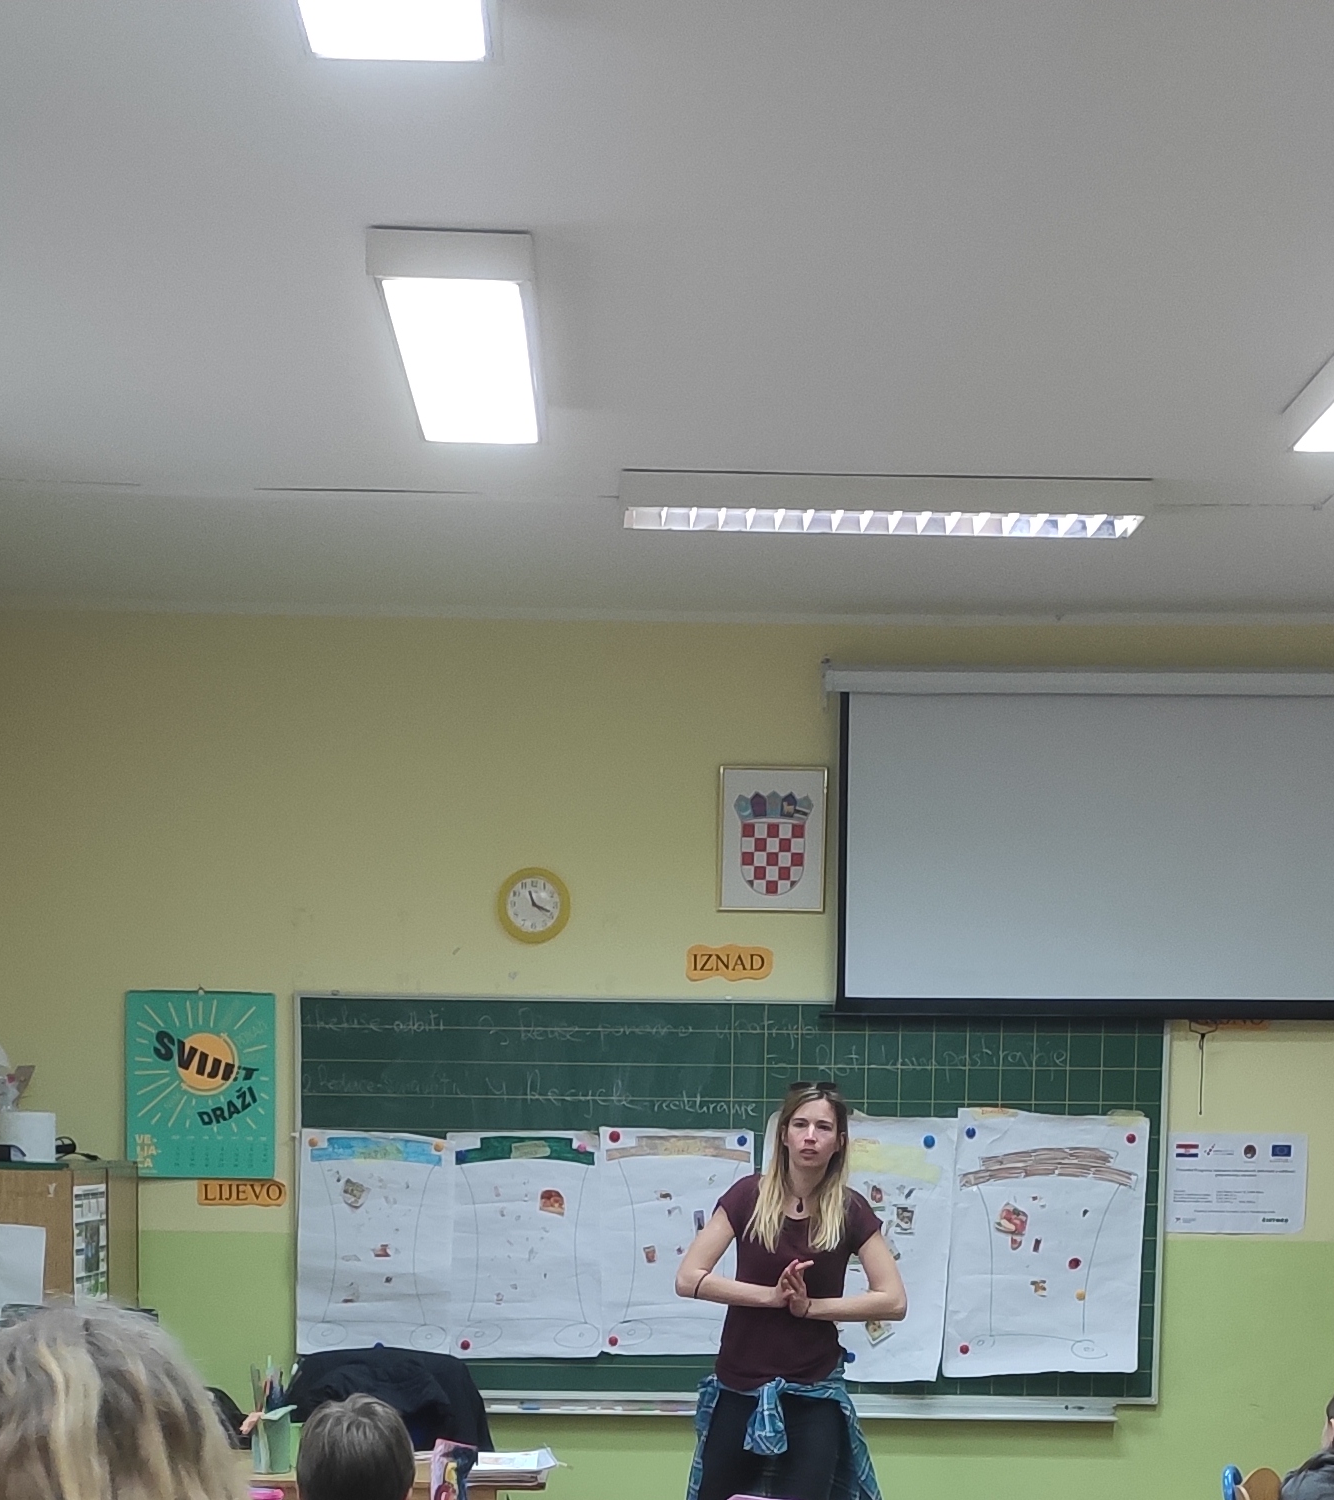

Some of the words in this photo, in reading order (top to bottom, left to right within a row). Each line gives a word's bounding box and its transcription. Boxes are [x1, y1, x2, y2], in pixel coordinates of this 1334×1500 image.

[692, 953, 765, 972] IZNAD
[153, 1029, 260, 1082] SVIJET
[196, 1085, 258, 1126] DRAŽI
[527, 1069, 643, 1118] Recycle
[203, 1184, 283, 1201] LIJEVO
